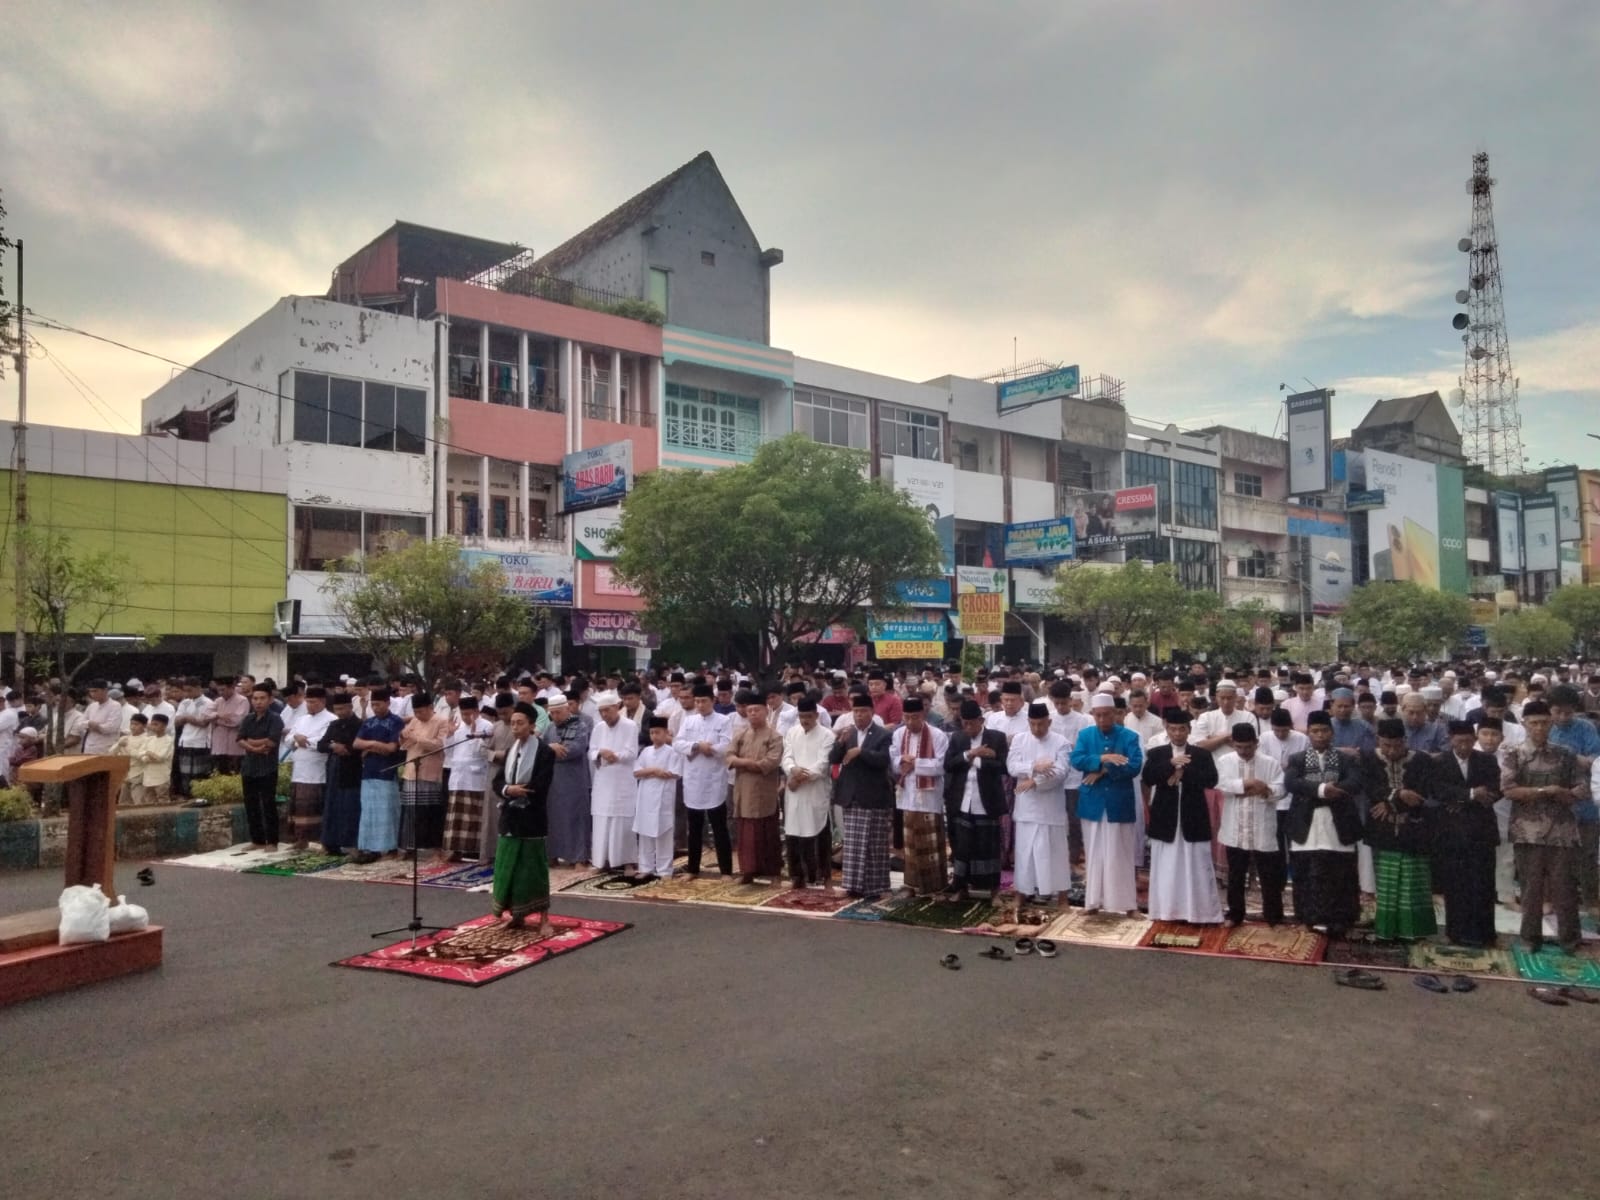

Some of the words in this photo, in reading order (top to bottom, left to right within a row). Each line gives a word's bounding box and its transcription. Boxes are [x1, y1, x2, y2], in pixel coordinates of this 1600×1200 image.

[587, 448, 604, 460] TOKO
[1116, 493, 1153, 505] CRESSIDA
[1087, 535, 1118, 545] ASUKA
[500, 555, 529, 566] TOKO
[961, 594, 1001, 613] GROSIR
[583, 627, 614, 641] Shoes
[615, 628, 625, 641] &
[885, 641, 934, 650] GROSIR
[879, 649, 926, 657] SERVICE
